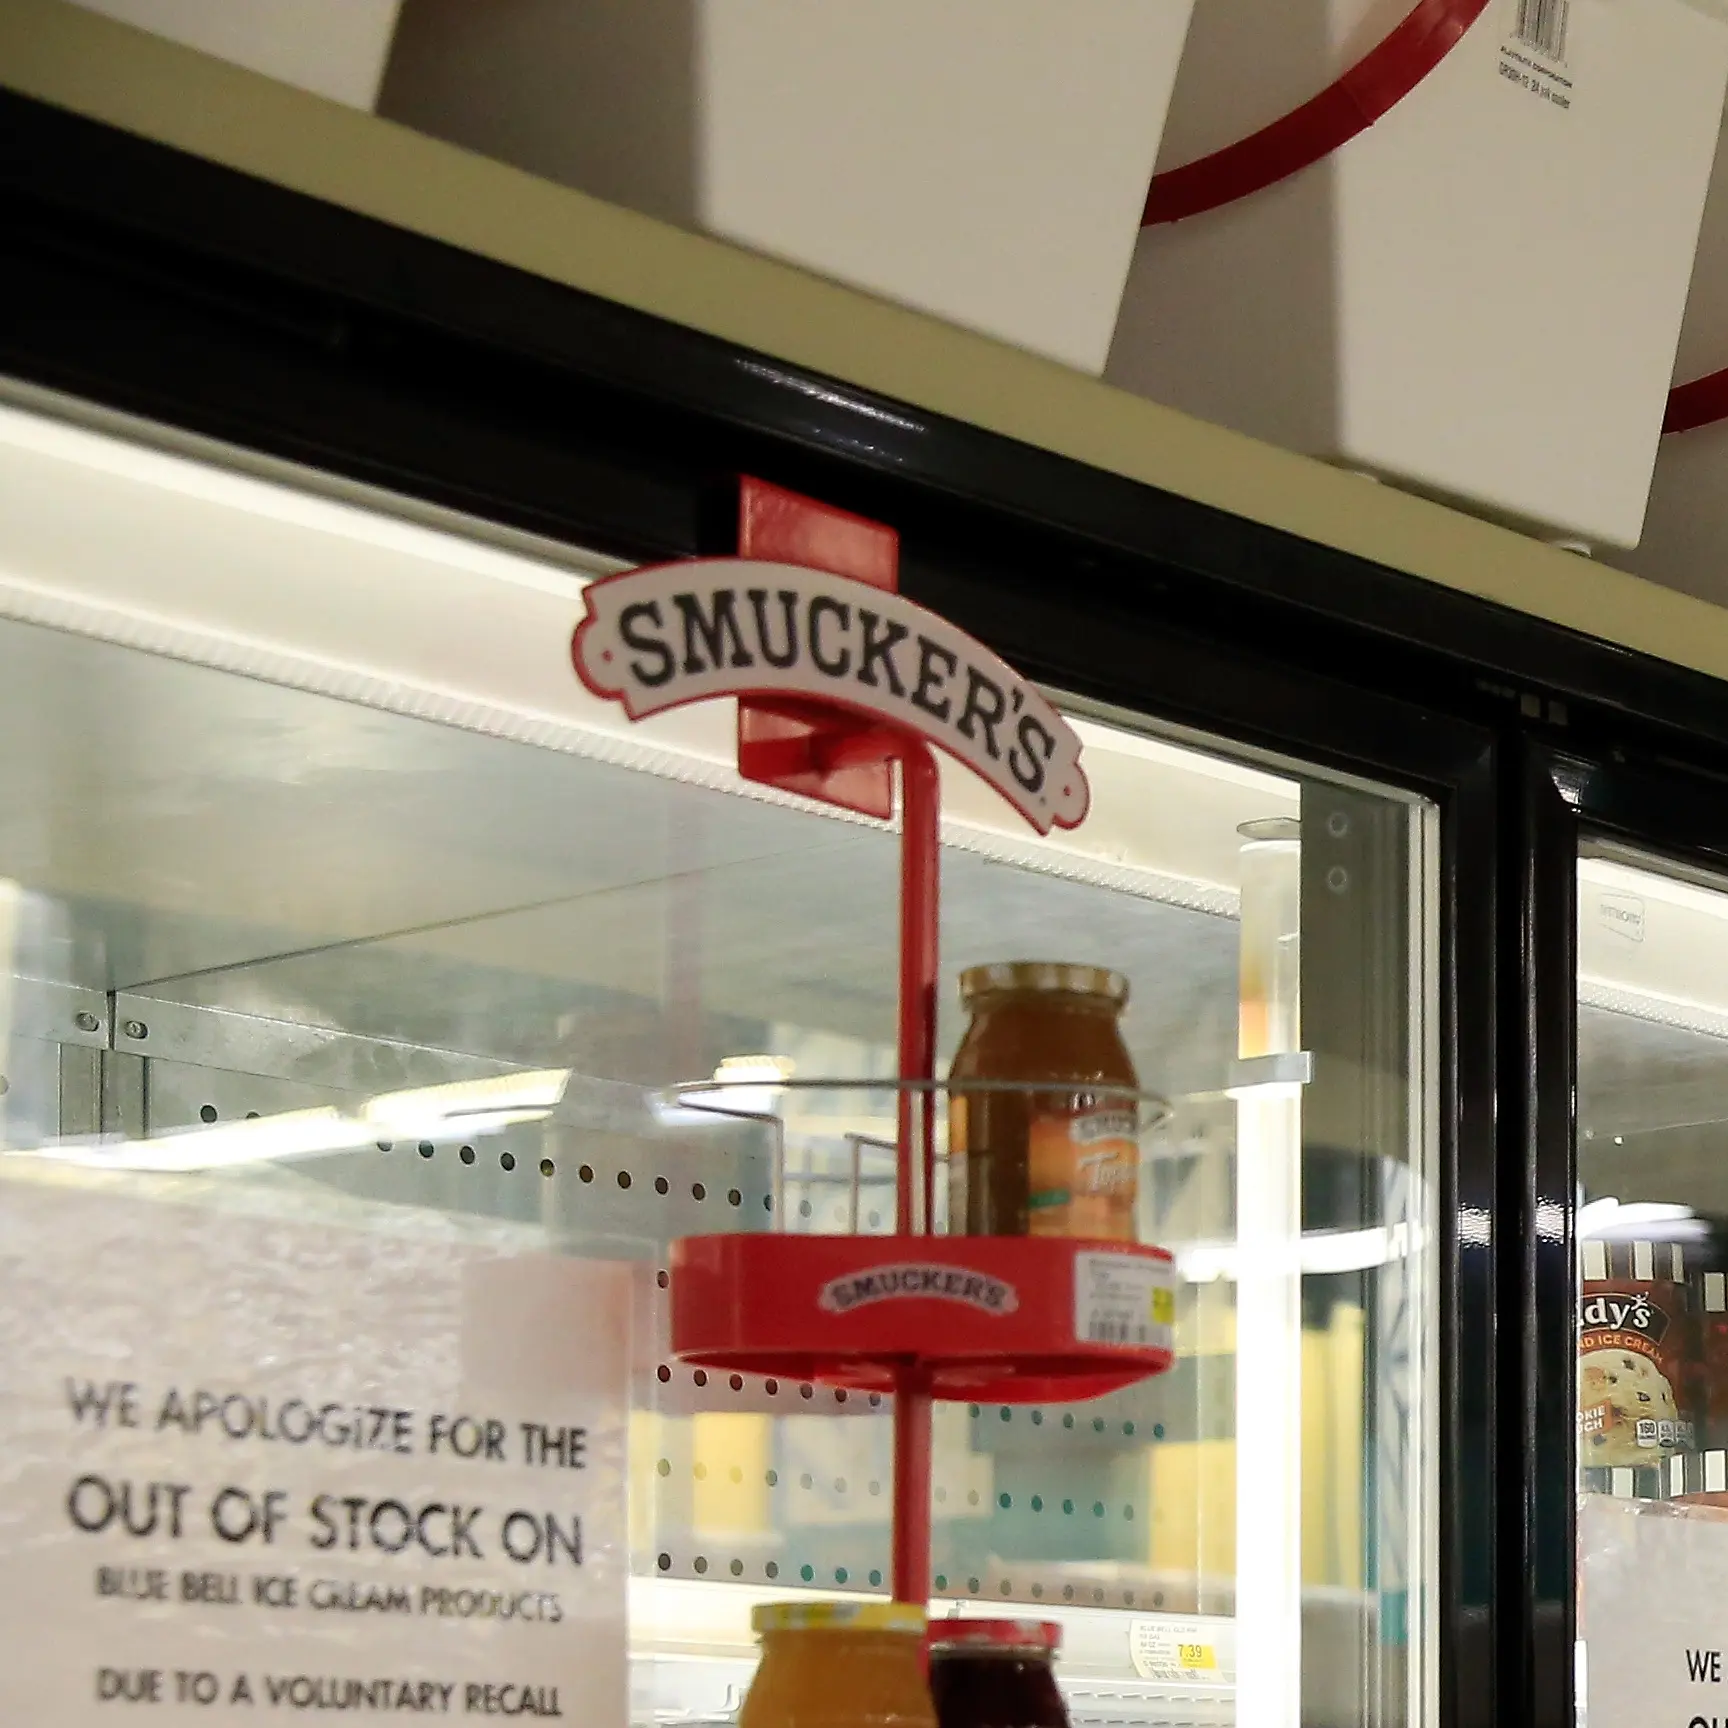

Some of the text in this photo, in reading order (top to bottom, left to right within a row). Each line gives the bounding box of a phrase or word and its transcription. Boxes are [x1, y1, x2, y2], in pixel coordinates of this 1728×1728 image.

[617, 588, 1057, 796] SMUCKER'S
[1580, 1292, 1652, 1331] dy's
[1598, 1334, 1622, 1346] ICE
[66, 1377, 588, 1469] WE APOLOGIZE FOR THE
[68, 1473, 584, 1566] OUT OF STOCK ON
[179, 1570, 243, 1605] BELL
[253, 1576, 298, 1609] ICE
[420, 1586, 564, 1623] PRODUCTS
[1177, 1644, 1203, 1658] 7.39
[1685, 1649, 1721, 1682] WE
[96, 1667, 564, 1718] DUE TO A VOLUNTARY RECALL
